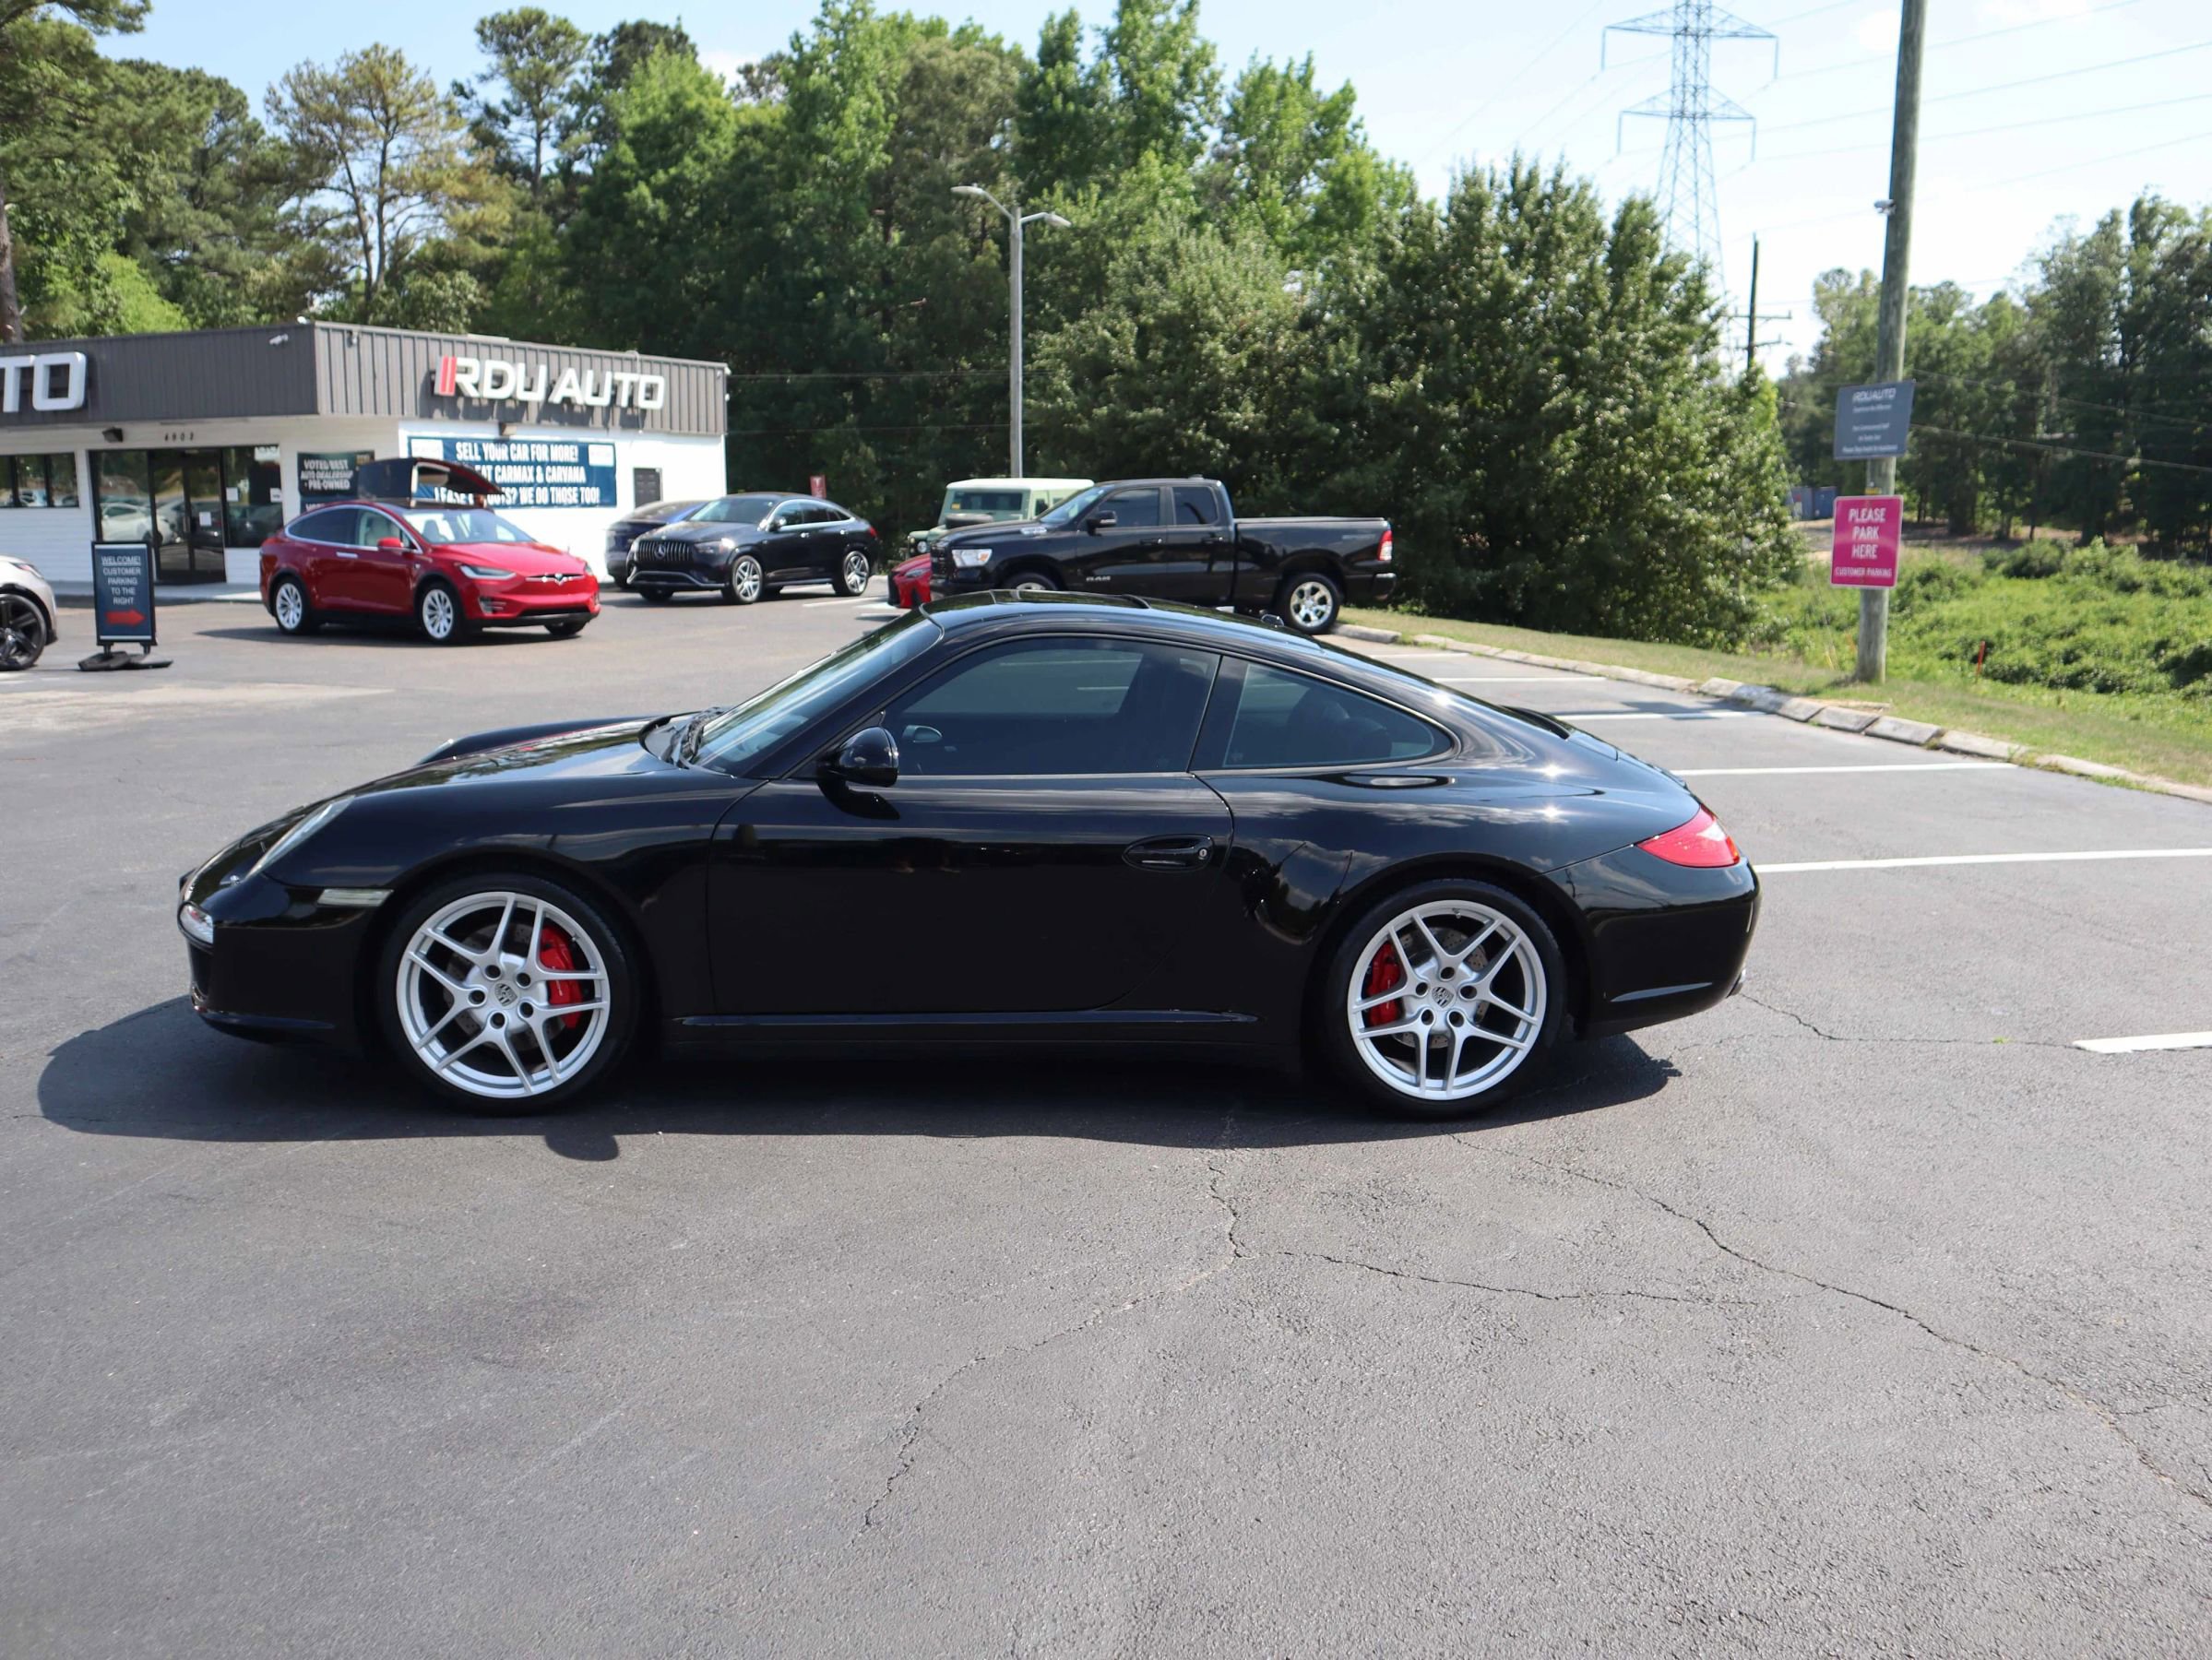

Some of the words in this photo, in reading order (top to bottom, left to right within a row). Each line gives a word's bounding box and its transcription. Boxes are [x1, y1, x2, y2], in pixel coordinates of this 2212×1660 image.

[548, 368, 665, 409] AUTO
[455, 442, 481, 461] SELL
[482, 442, 509, 461] YOUR
[509, 443, 530, 462] CAR
[530, 444, 550, 462] FOR
[550, 445, 579, 462] MORE!
[494, 465, 534, 483] CARMAX
[535, 466, 544, 483] &
[545, 466, 587, 484] CARVANA
[518, 486, 534, 505] WE
[535, 486, 549, 505] DO
[549, 486, 579, 504] THOSE
[579, 486, 601, 504] TOO!
[1849, 508, 1886, 523] PLEASE
[1852, 526, 1879, 540] PARK
[1851, 544, 1878, 559] HERE
[101, 555, 141, 566] WELCOME!
[102, 566, 141, 576] CUSTOMER
[1835, 566, 1865, 576] CUSTOMER
[1866, 567, 1893, 578] PARKING
[107, 577, 137, 587] PARKING
[111, 587, 122, 596] TO
[122, 587, 136, 596] THE
[113, 597, 135, 606] RIGHT
